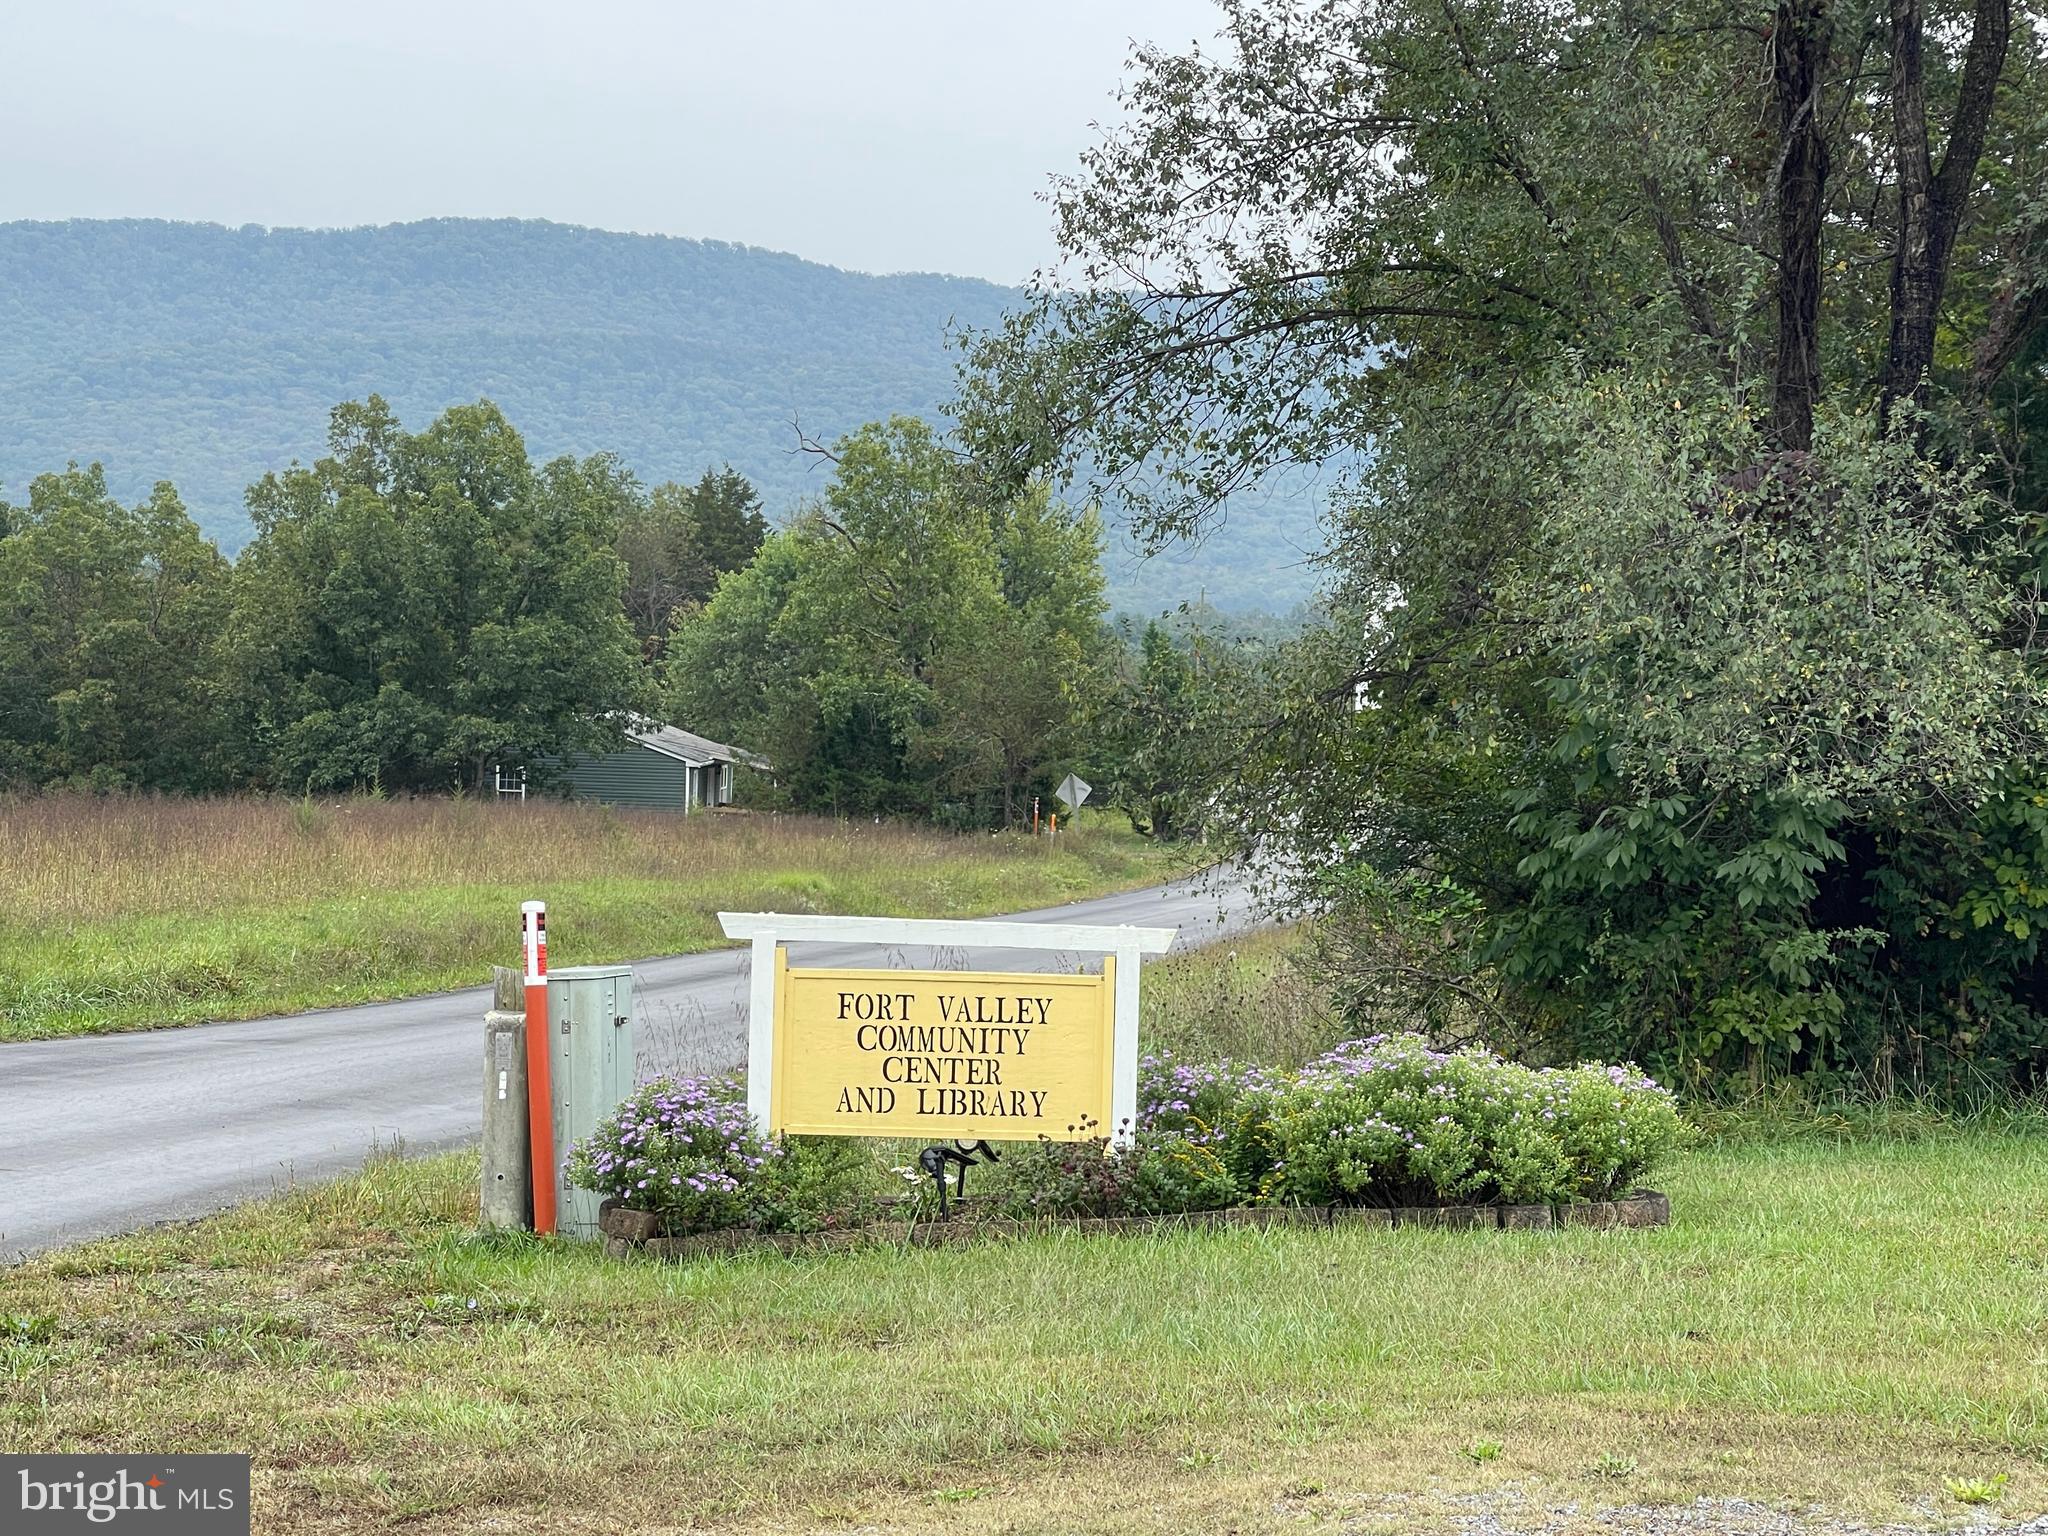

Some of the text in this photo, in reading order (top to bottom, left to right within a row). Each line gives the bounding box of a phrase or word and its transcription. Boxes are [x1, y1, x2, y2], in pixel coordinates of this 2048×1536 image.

[837, 992, 1054, 1025] FORT VALLEY
[857, 1024, 1031, 1056] COMMUNITY
[882, 1056, 1003, 1086] CENTER
[836, 1086, 1048, 1118] AND LIBRARY
